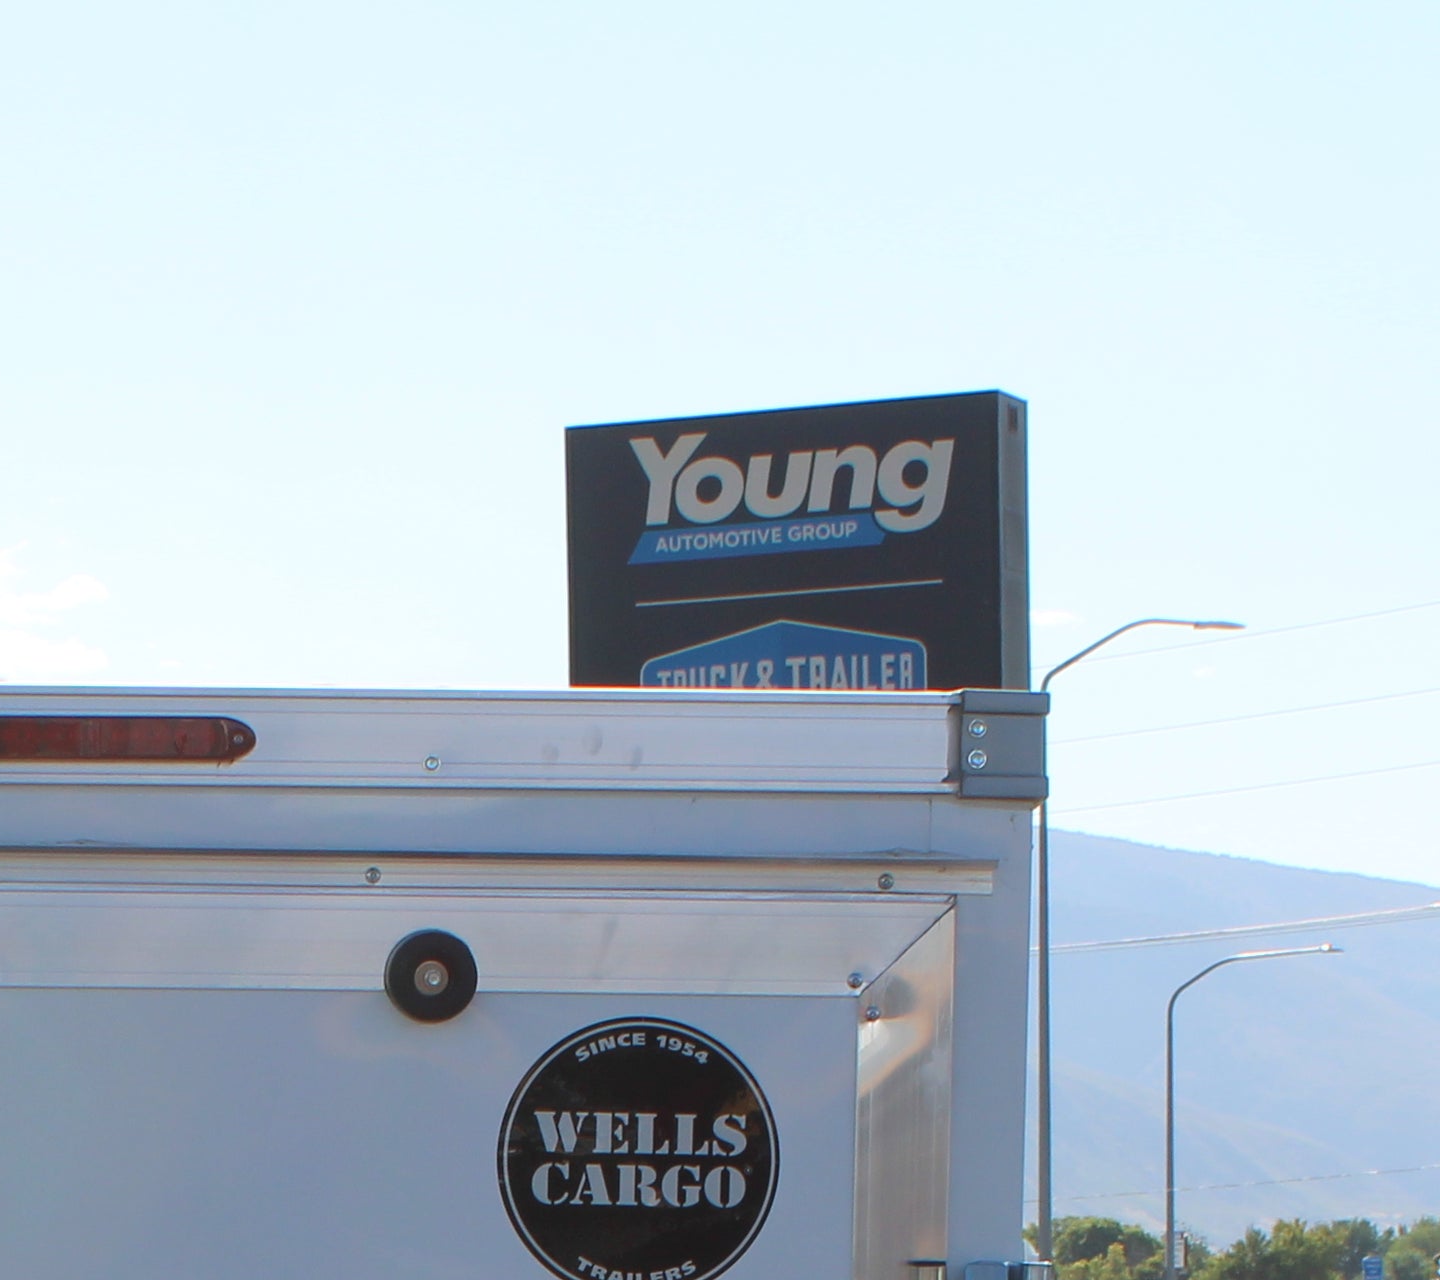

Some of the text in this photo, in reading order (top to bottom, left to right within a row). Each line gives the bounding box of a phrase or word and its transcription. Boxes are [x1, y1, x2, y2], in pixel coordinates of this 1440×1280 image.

[629, 432, 956, 533] Young
[655, 520, 858, 553] AUTOMOTIVE GROUP
[785, 652, 913, 690] TRAILER
[574, 1032, 710, 1065] SINCE 1954
[533, 1110, 748, 1157] WELLS
[531, 1161, 746, 1208] CARGO
